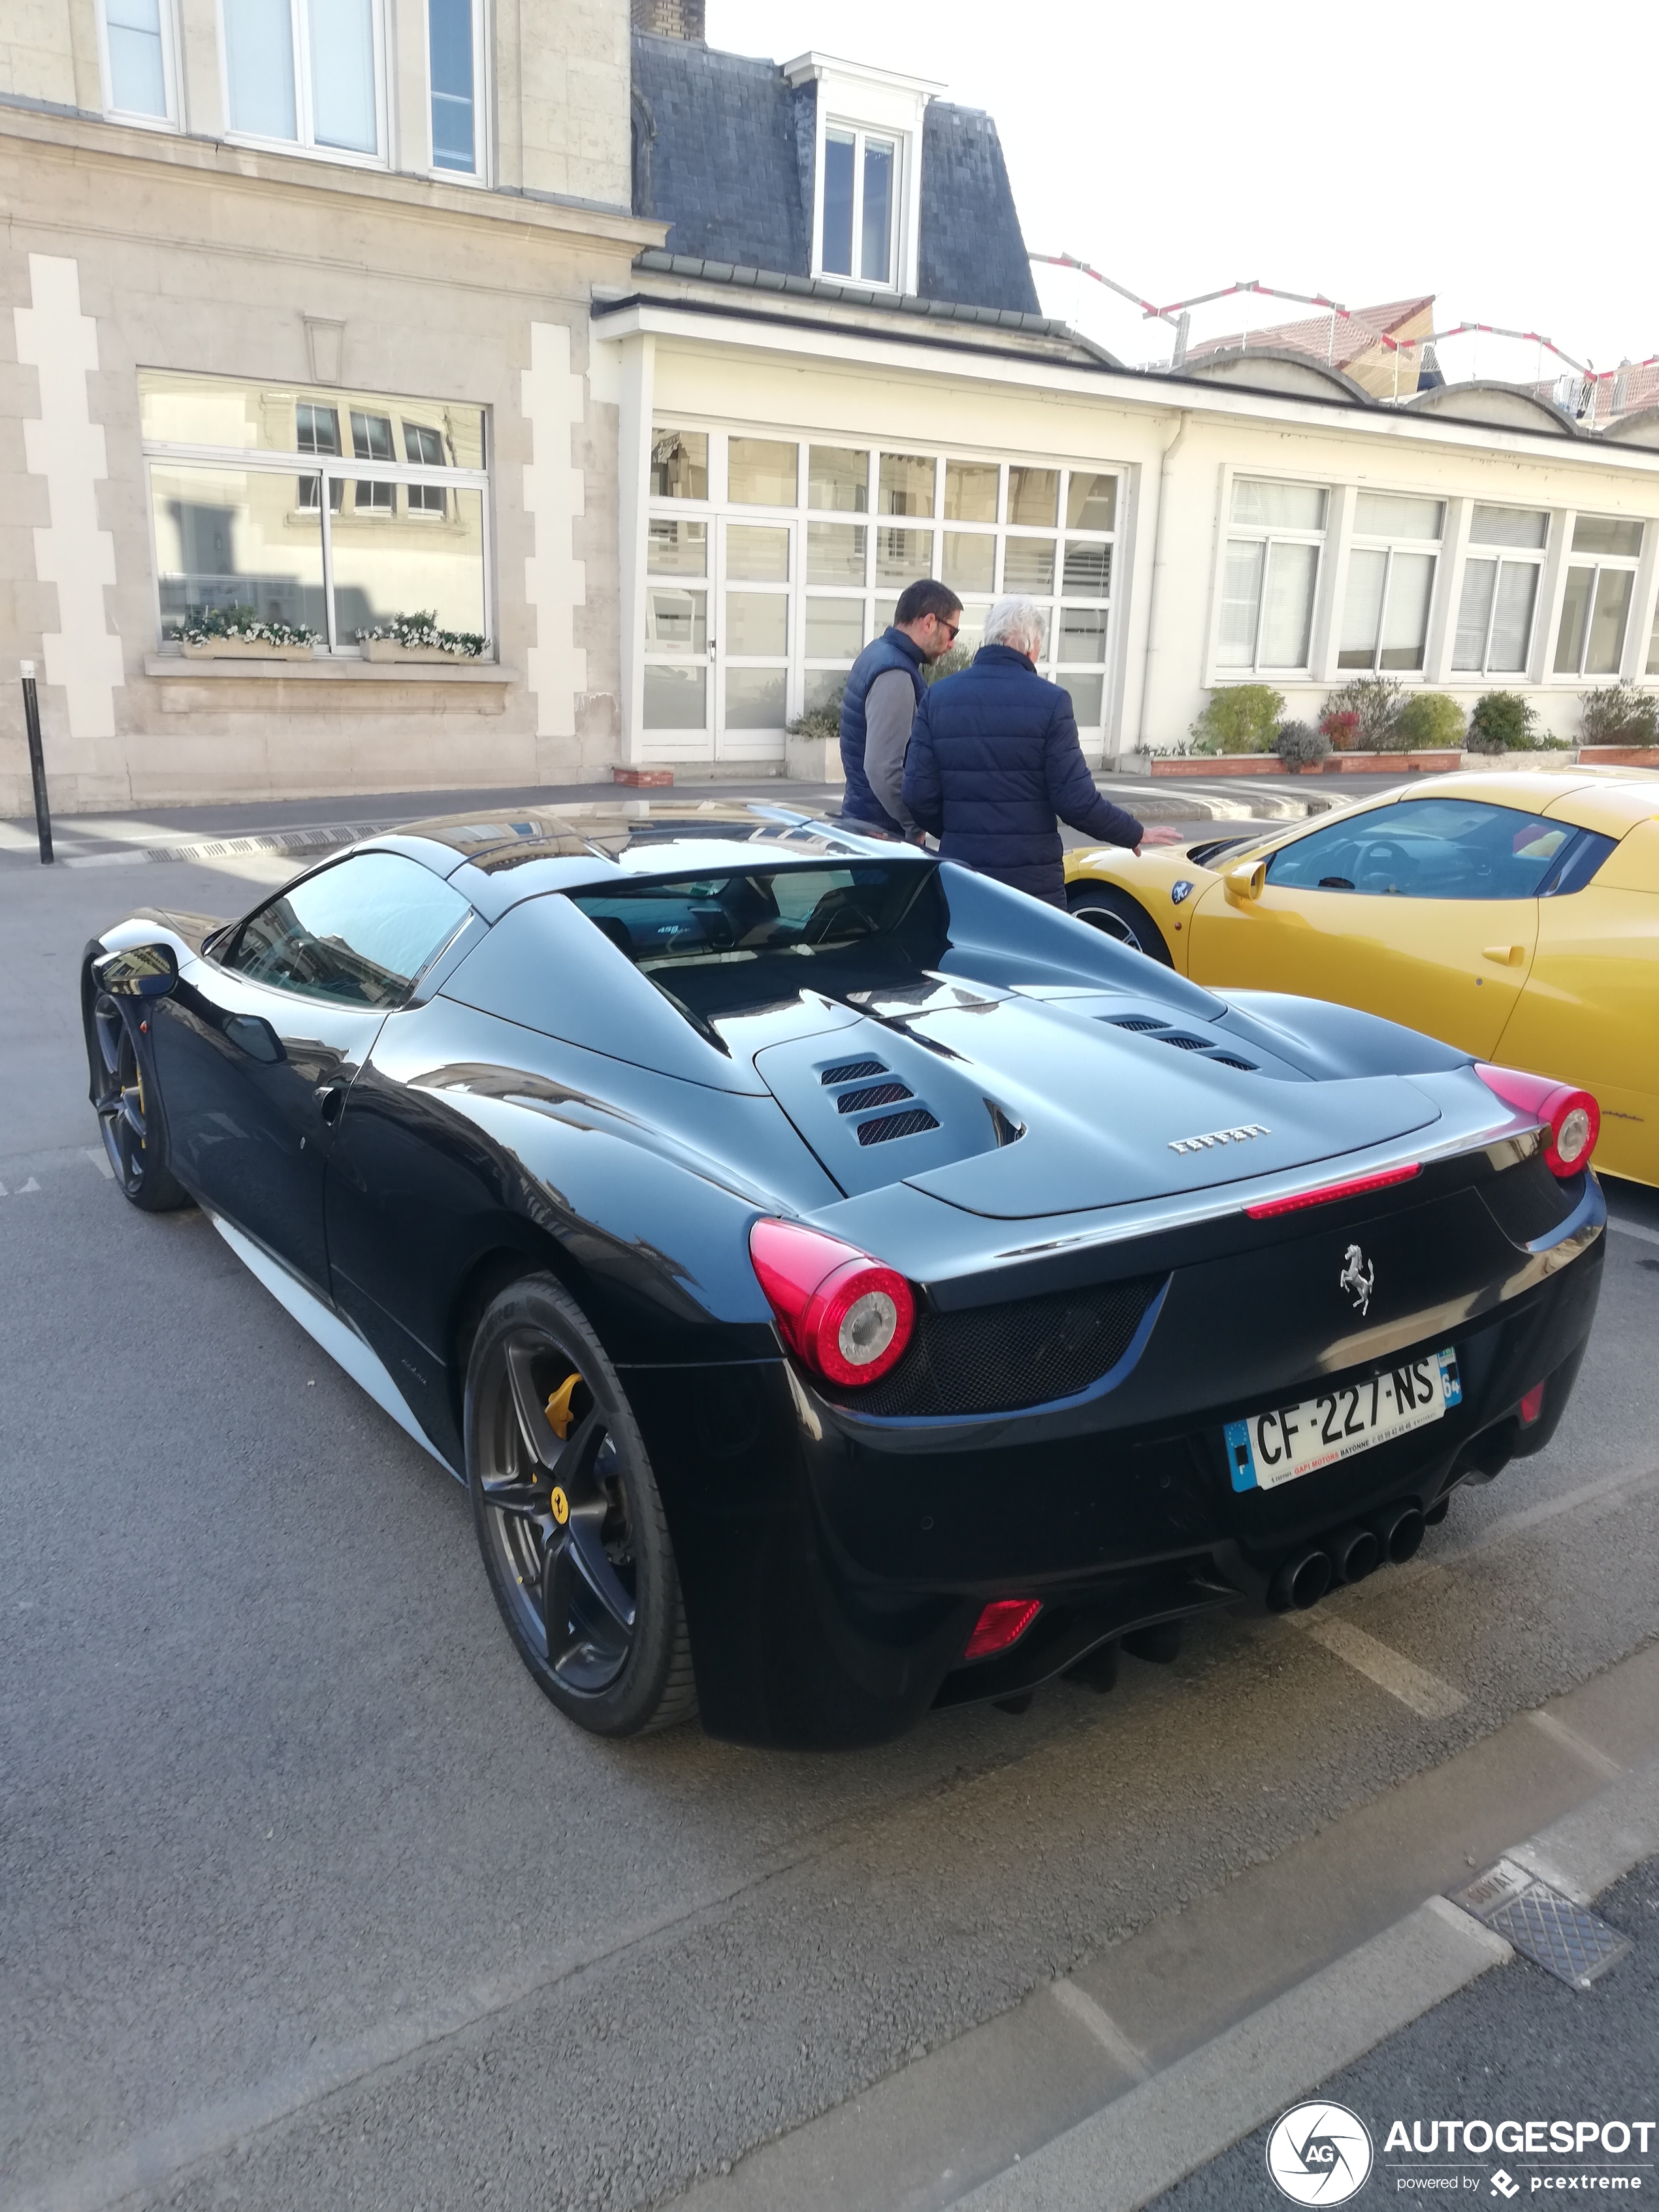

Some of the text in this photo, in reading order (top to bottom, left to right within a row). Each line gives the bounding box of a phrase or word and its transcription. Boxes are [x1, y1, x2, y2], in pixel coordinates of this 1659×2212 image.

[1442, 1373, 1461, 1398] 64
[1257, 1358, 1434, 1465] CF-227-NS
[1312, 1451, 1339, 1469] MOTORS
[1340, 1439, 1370, 1457] BAYONNE
